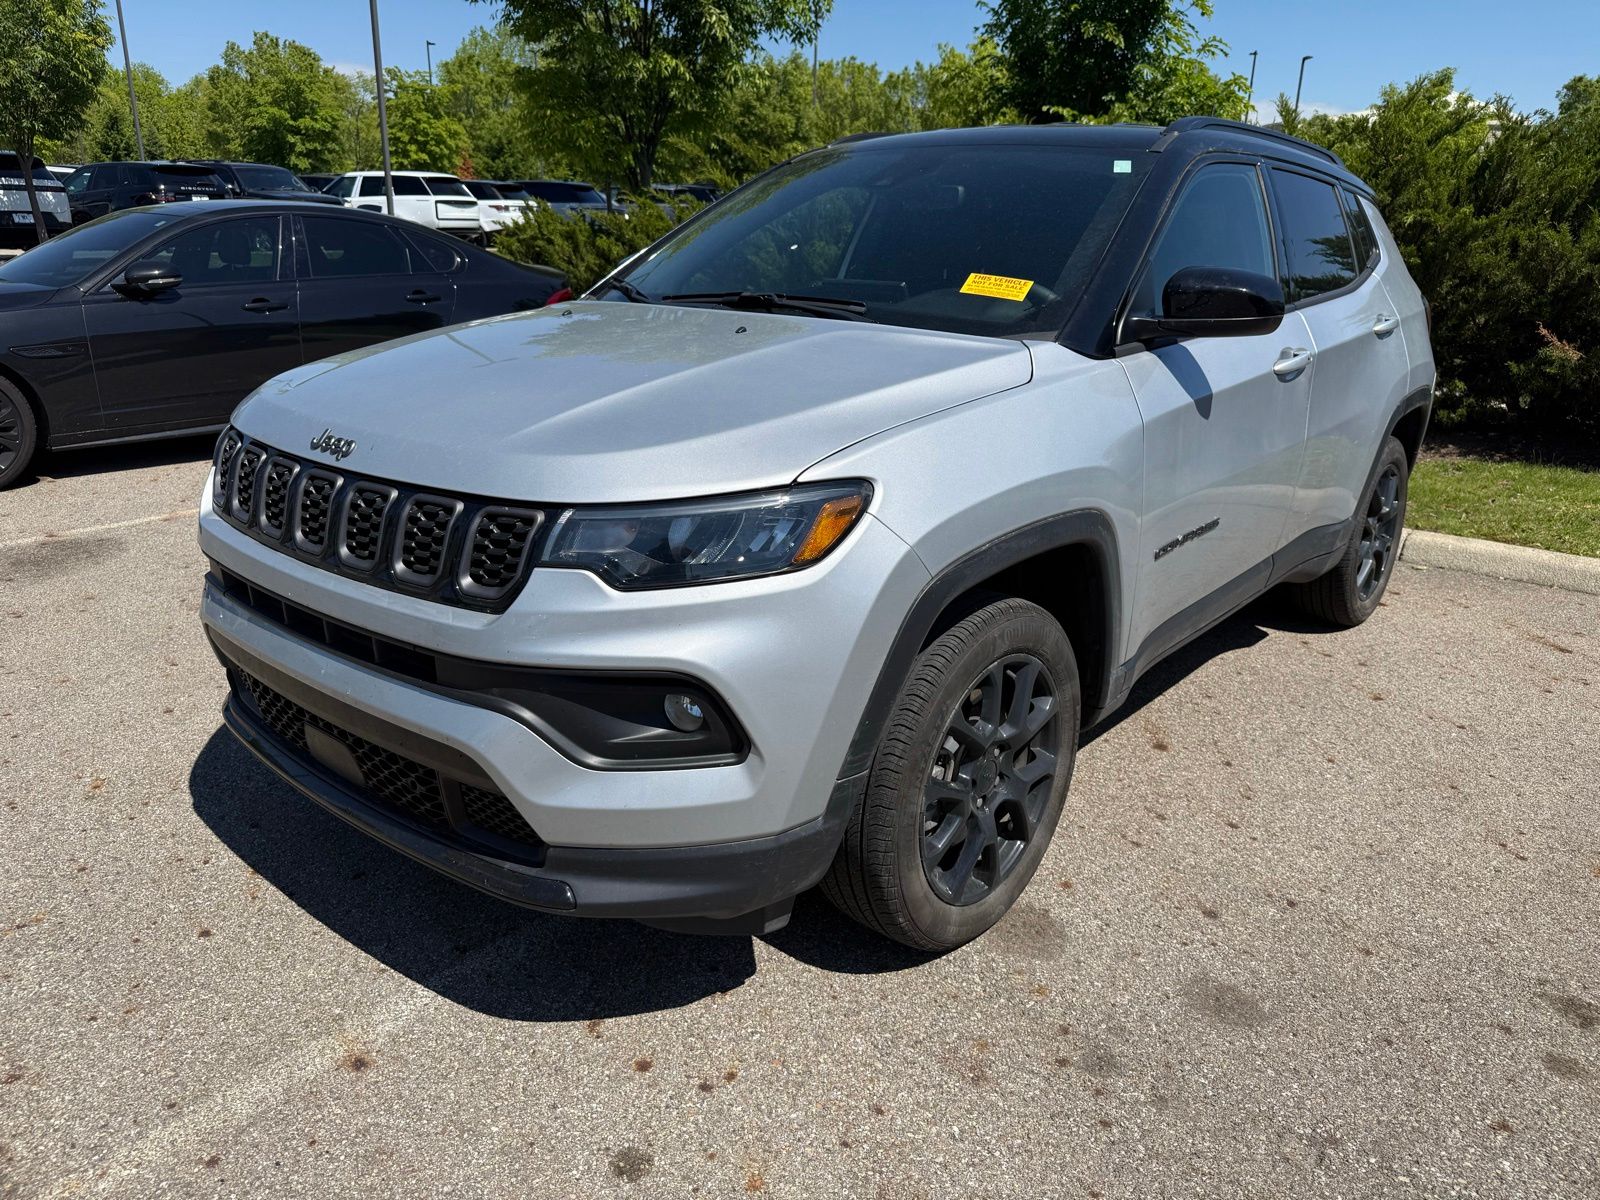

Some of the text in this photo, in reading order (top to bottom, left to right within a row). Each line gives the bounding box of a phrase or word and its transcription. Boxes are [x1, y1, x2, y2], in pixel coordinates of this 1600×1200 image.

[973, 274, 1030, 287] THIS VEHICLE
[310, 428, 356, 462] Jeep
